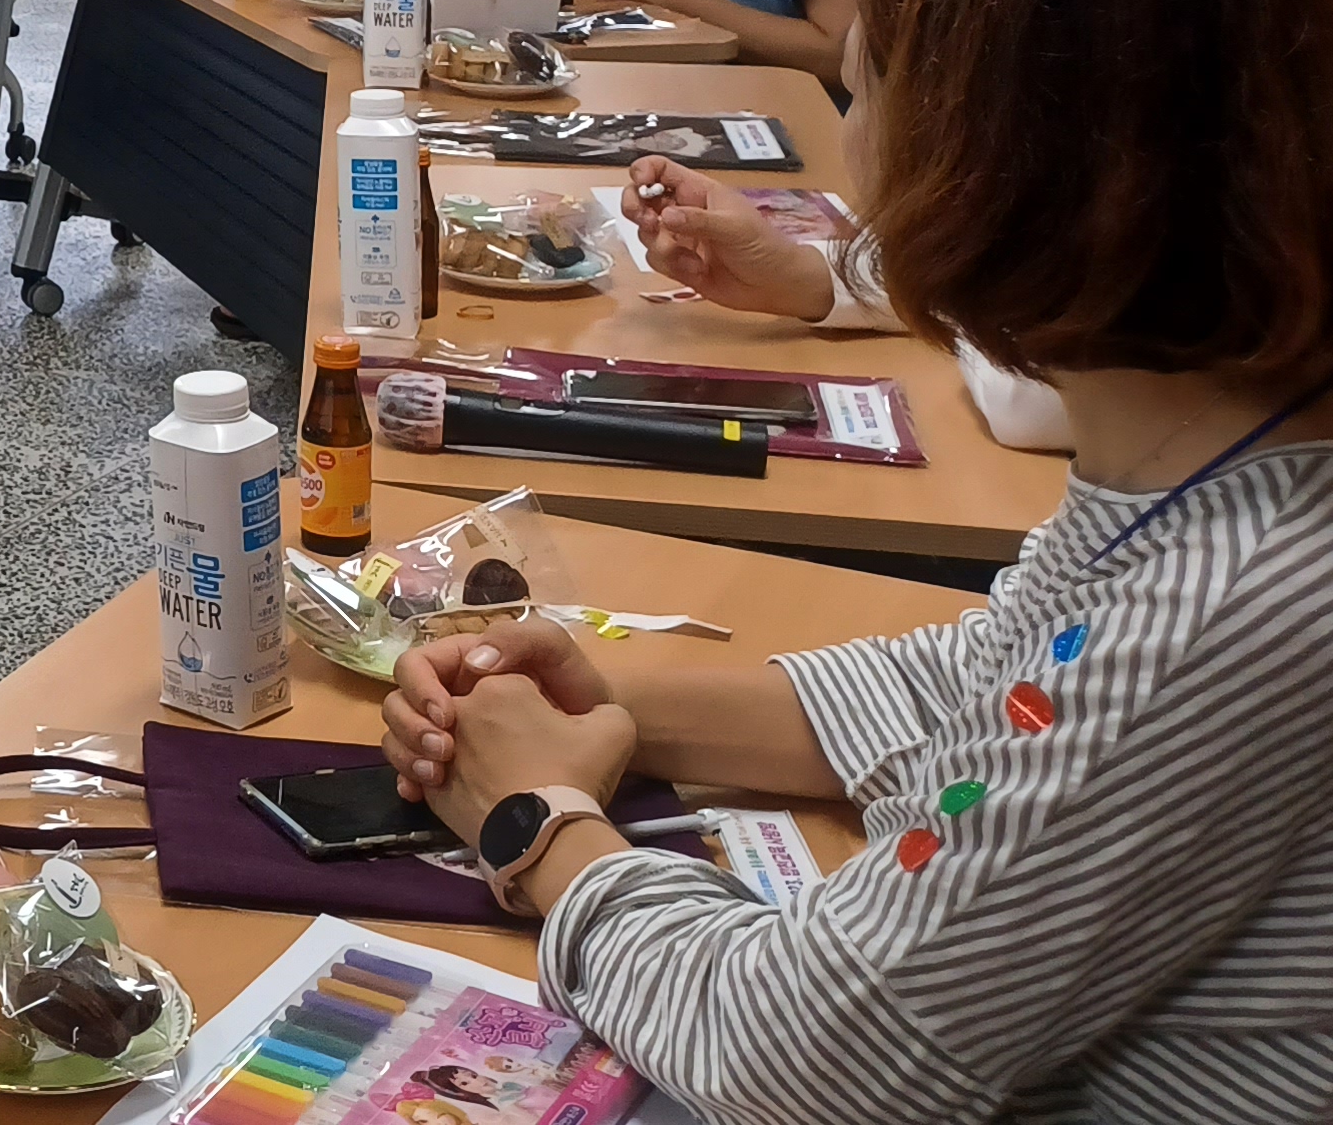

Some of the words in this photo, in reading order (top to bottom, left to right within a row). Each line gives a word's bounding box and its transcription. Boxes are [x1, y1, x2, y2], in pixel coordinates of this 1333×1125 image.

[373, 11, 414, 28] WATER
[156, 542, 186, 573] 기픈
[186, 552, 226, 599] 물
[159, 584, 222, 631] WATER
